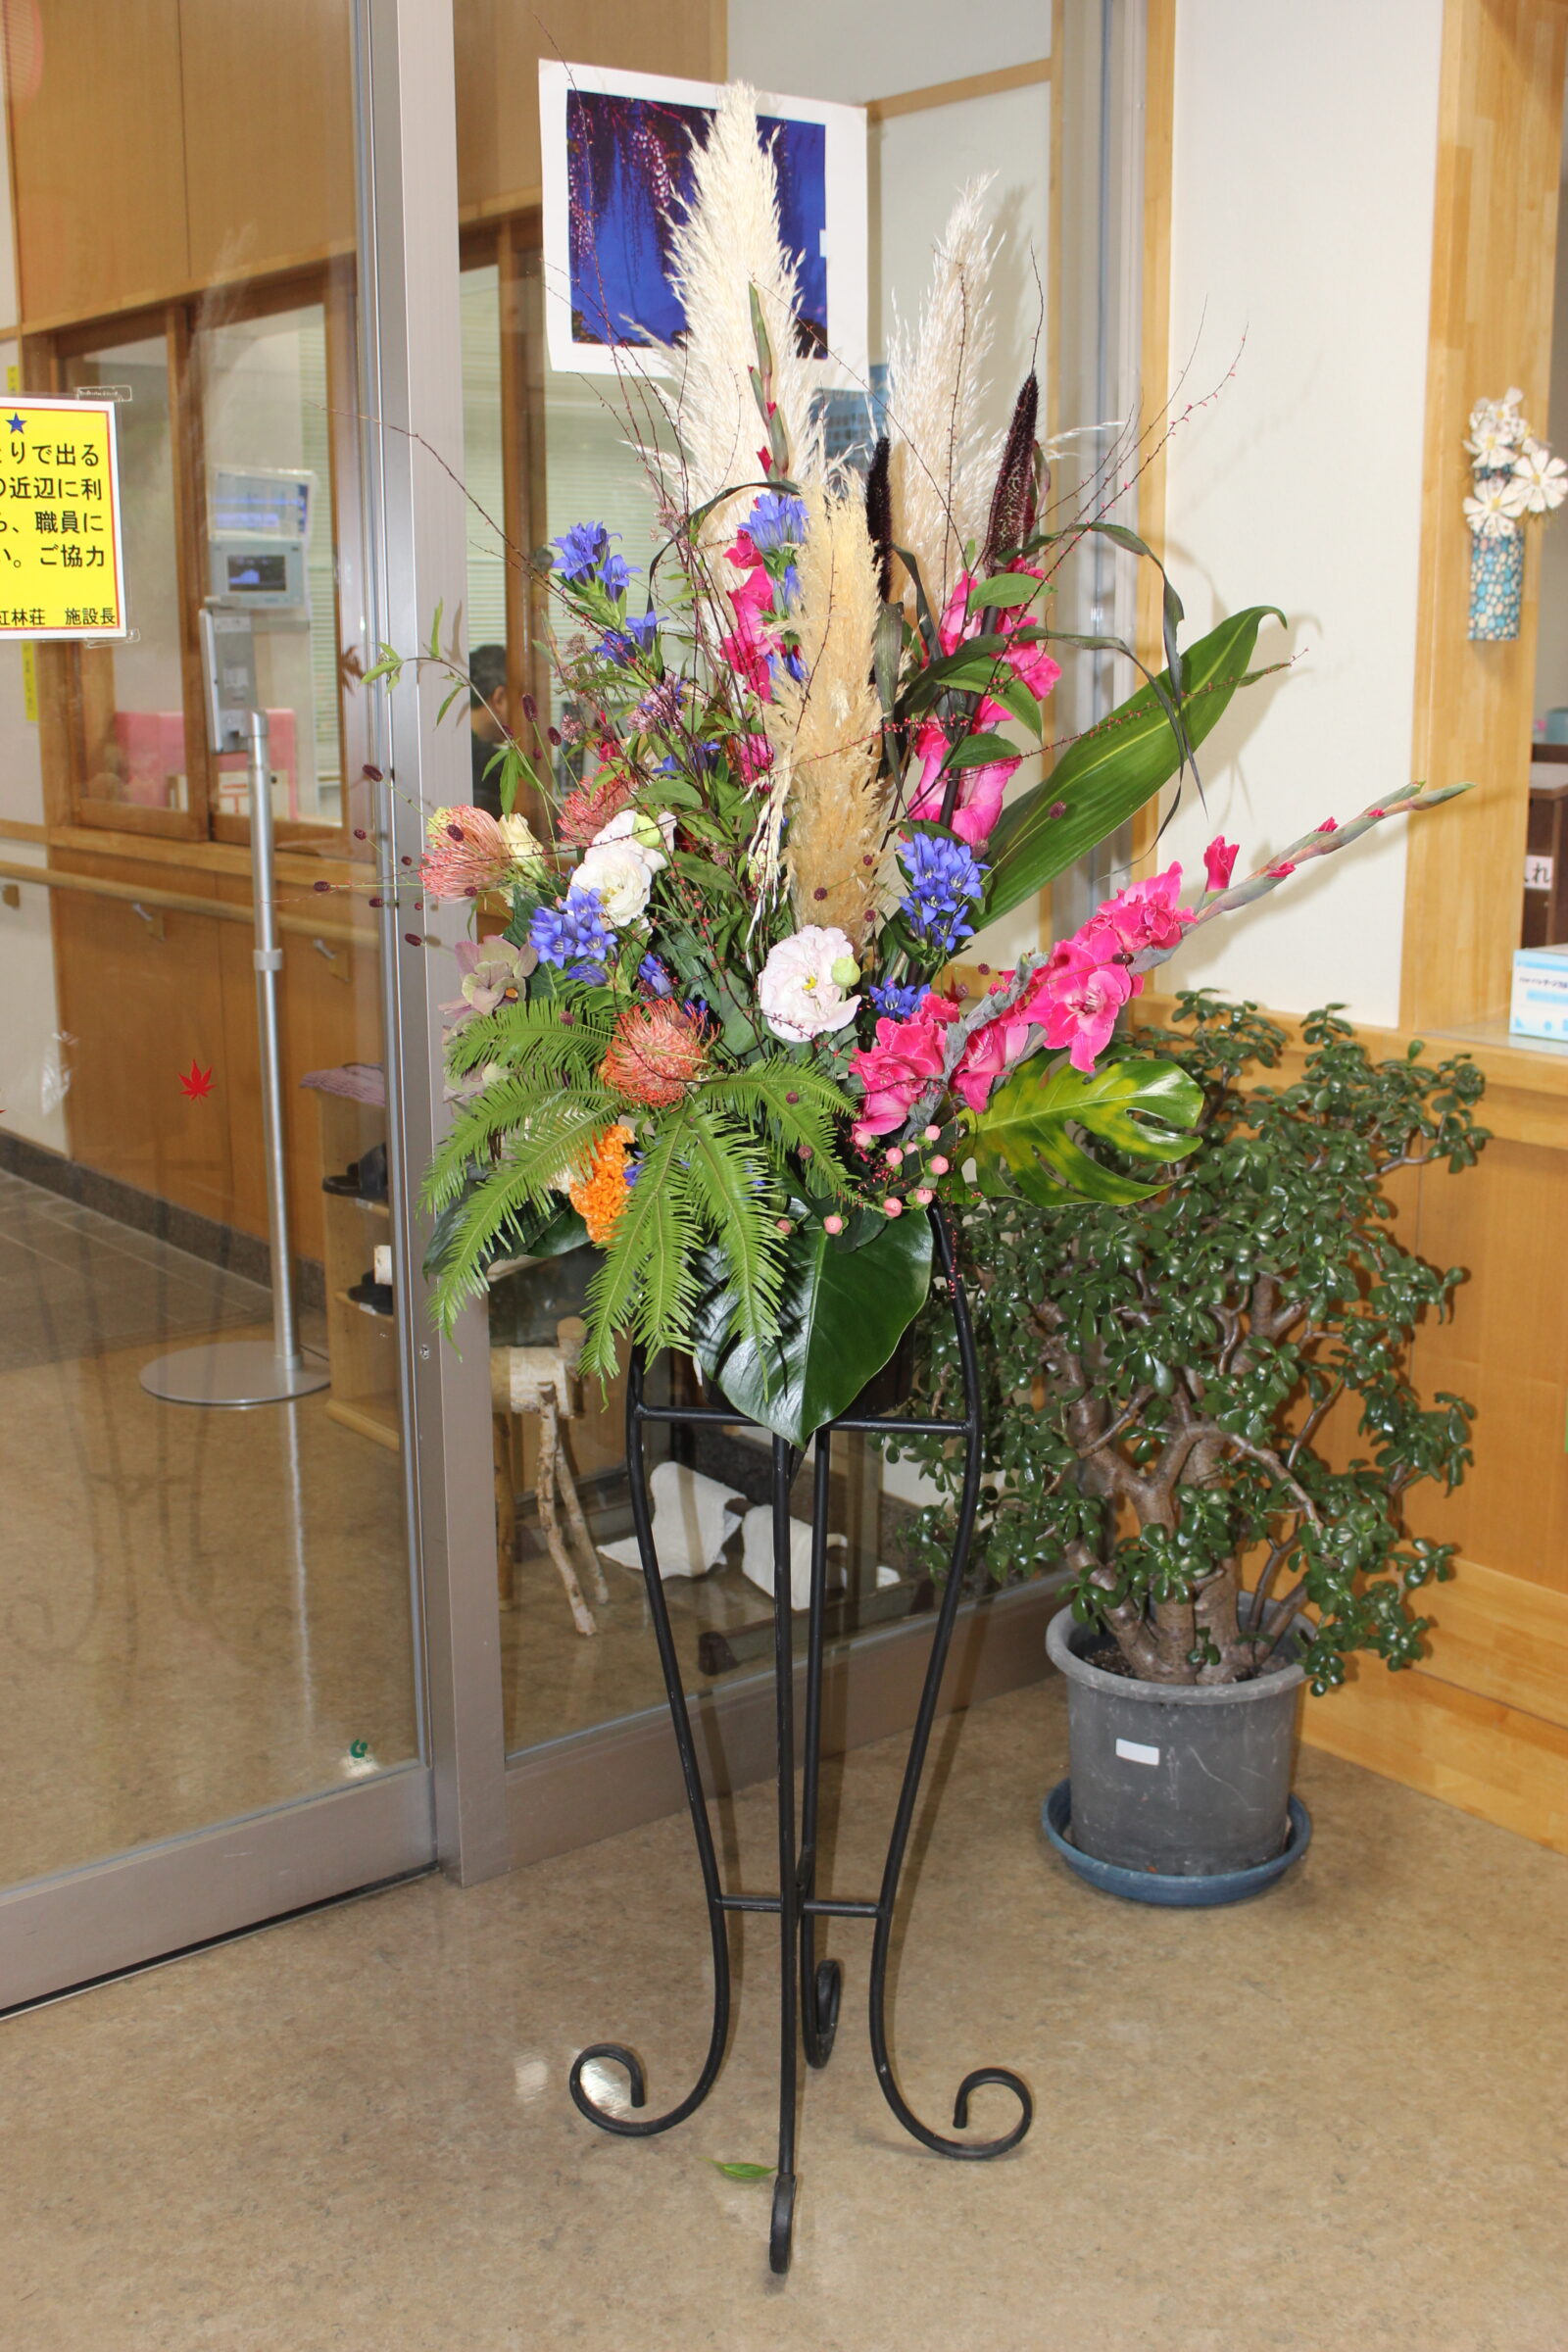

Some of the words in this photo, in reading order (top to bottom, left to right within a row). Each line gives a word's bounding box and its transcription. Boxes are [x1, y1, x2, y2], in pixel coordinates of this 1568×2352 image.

[0, 441, 99, 466] りで出る
[65, 608, 116, 625] 施設長
